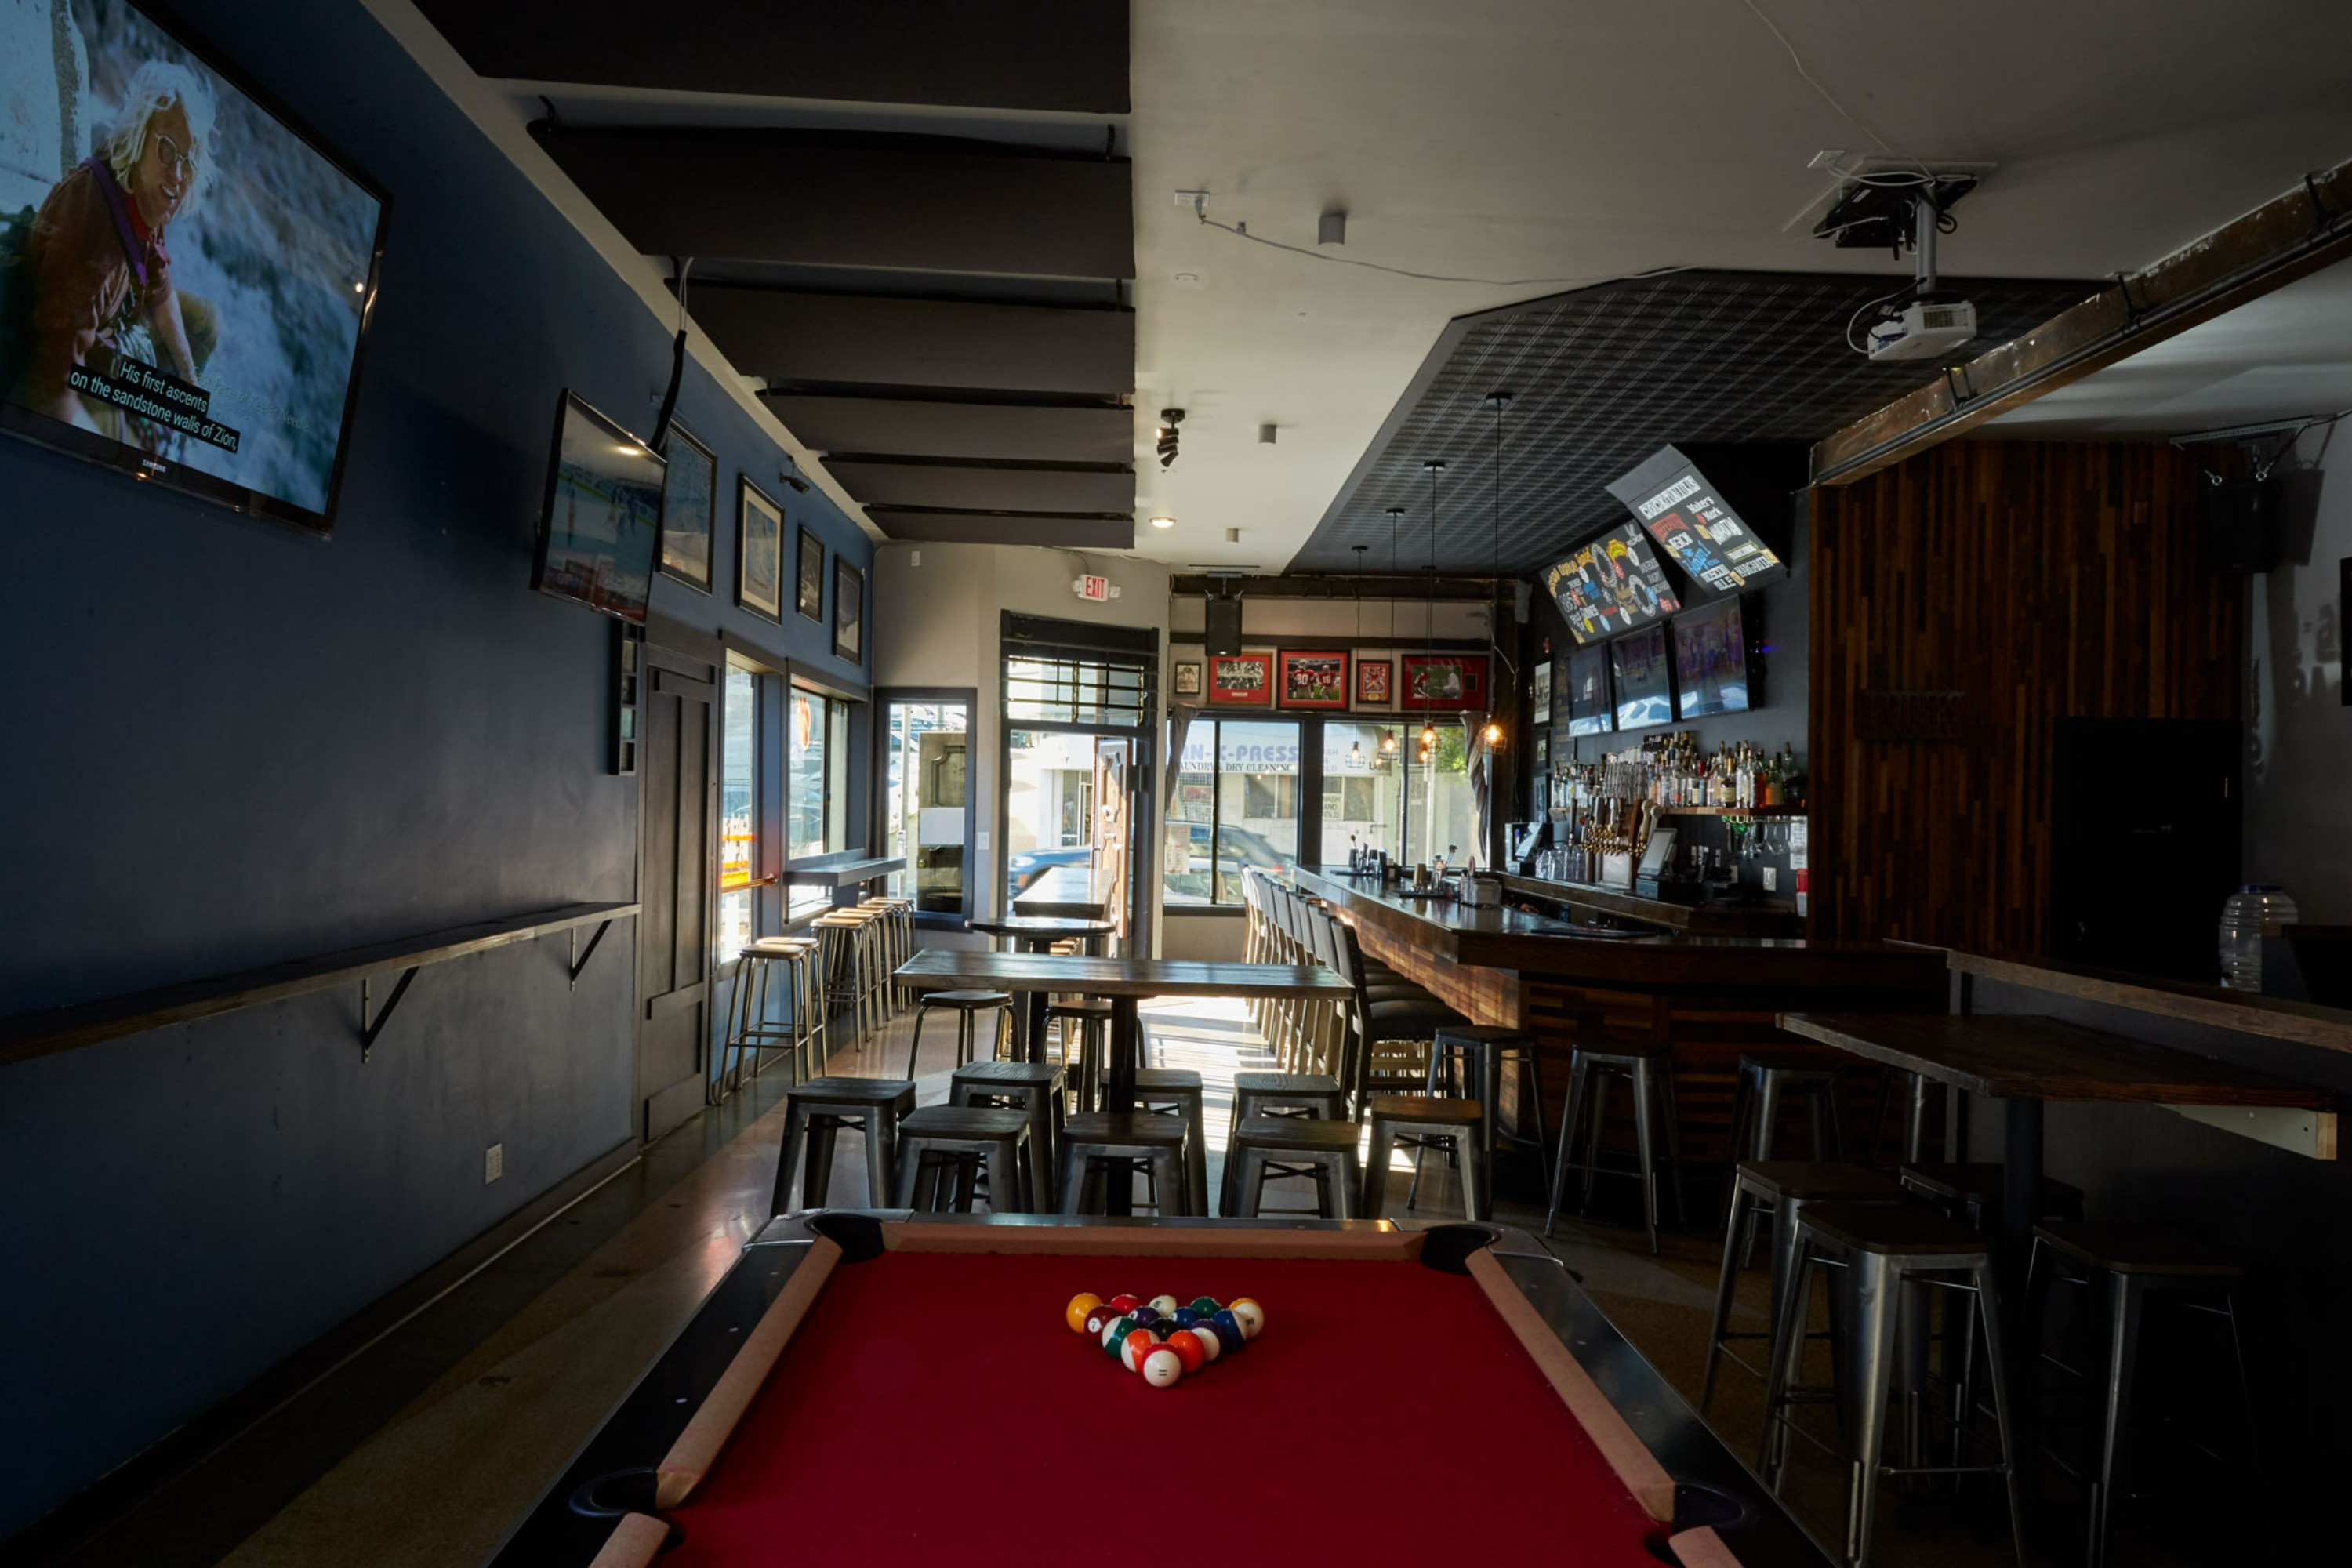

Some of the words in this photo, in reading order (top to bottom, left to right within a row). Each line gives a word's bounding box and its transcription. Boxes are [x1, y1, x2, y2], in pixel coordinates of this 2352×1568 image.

[119, 360, 140, 385] His
[142, 370, 165, 396] first
[165, 383, 209, 413] ascents
[70, 371, 89, 390] on
[90, 375, 111, 399] the
[111, 387, 172, 423] sandstone
[172, 409, 200, 434] walls
[201, 423, 214, 440] of
[212, 426, 238, 452] Zion,
[1085, 576, 1105, 599] EXIT
[1179, 762, 1215, 771] AUNDRY
[1225, 763, 1244, 772] DRY
